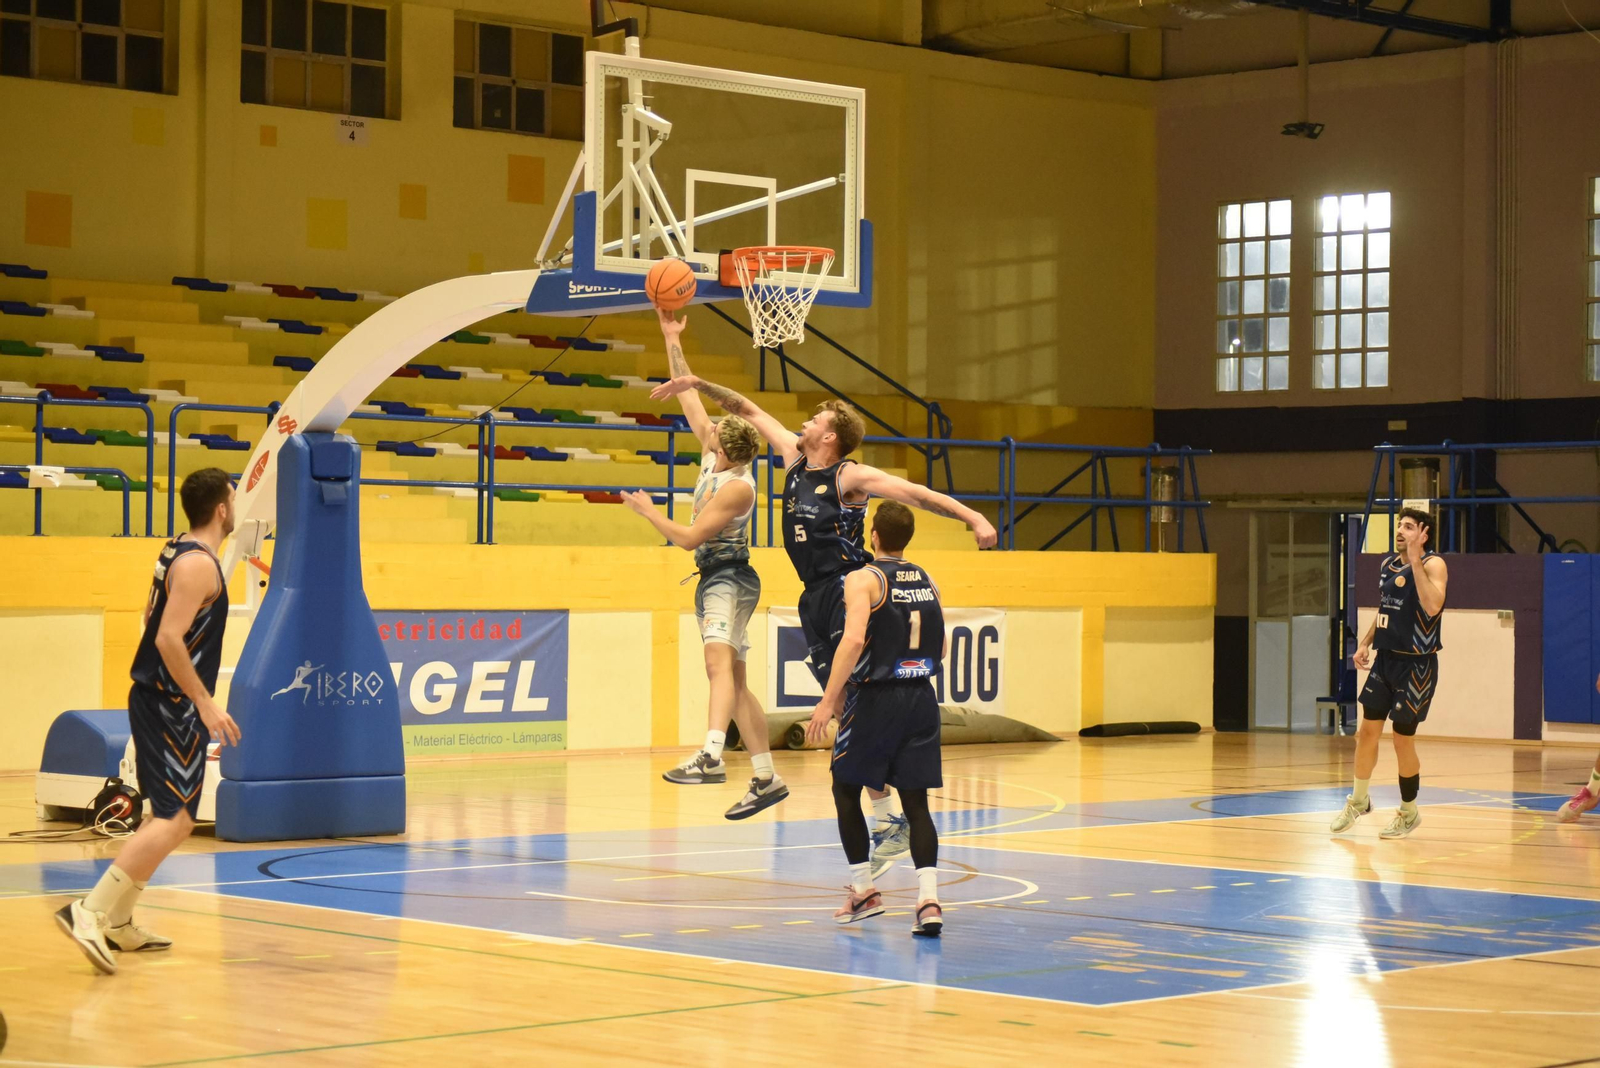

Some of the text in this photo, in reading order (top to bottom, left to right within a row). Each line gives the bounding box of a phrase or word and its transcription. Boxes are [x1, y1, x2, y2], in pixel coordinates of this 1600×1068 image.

[340, 120, 365, 128] SECTOR
[349, 130, 356, 141] 4
[895, 570, 922, 582] SEARA
[908, 609, 922, 650] 1
[317, 670, 384, 700] IBERO
[317, 698, 384, 707] SPORT
[413, 734, 455, 747] Material
[458, 732, 503, 746] Eléctrico
[513, 731, 563, 744] Lámparas
